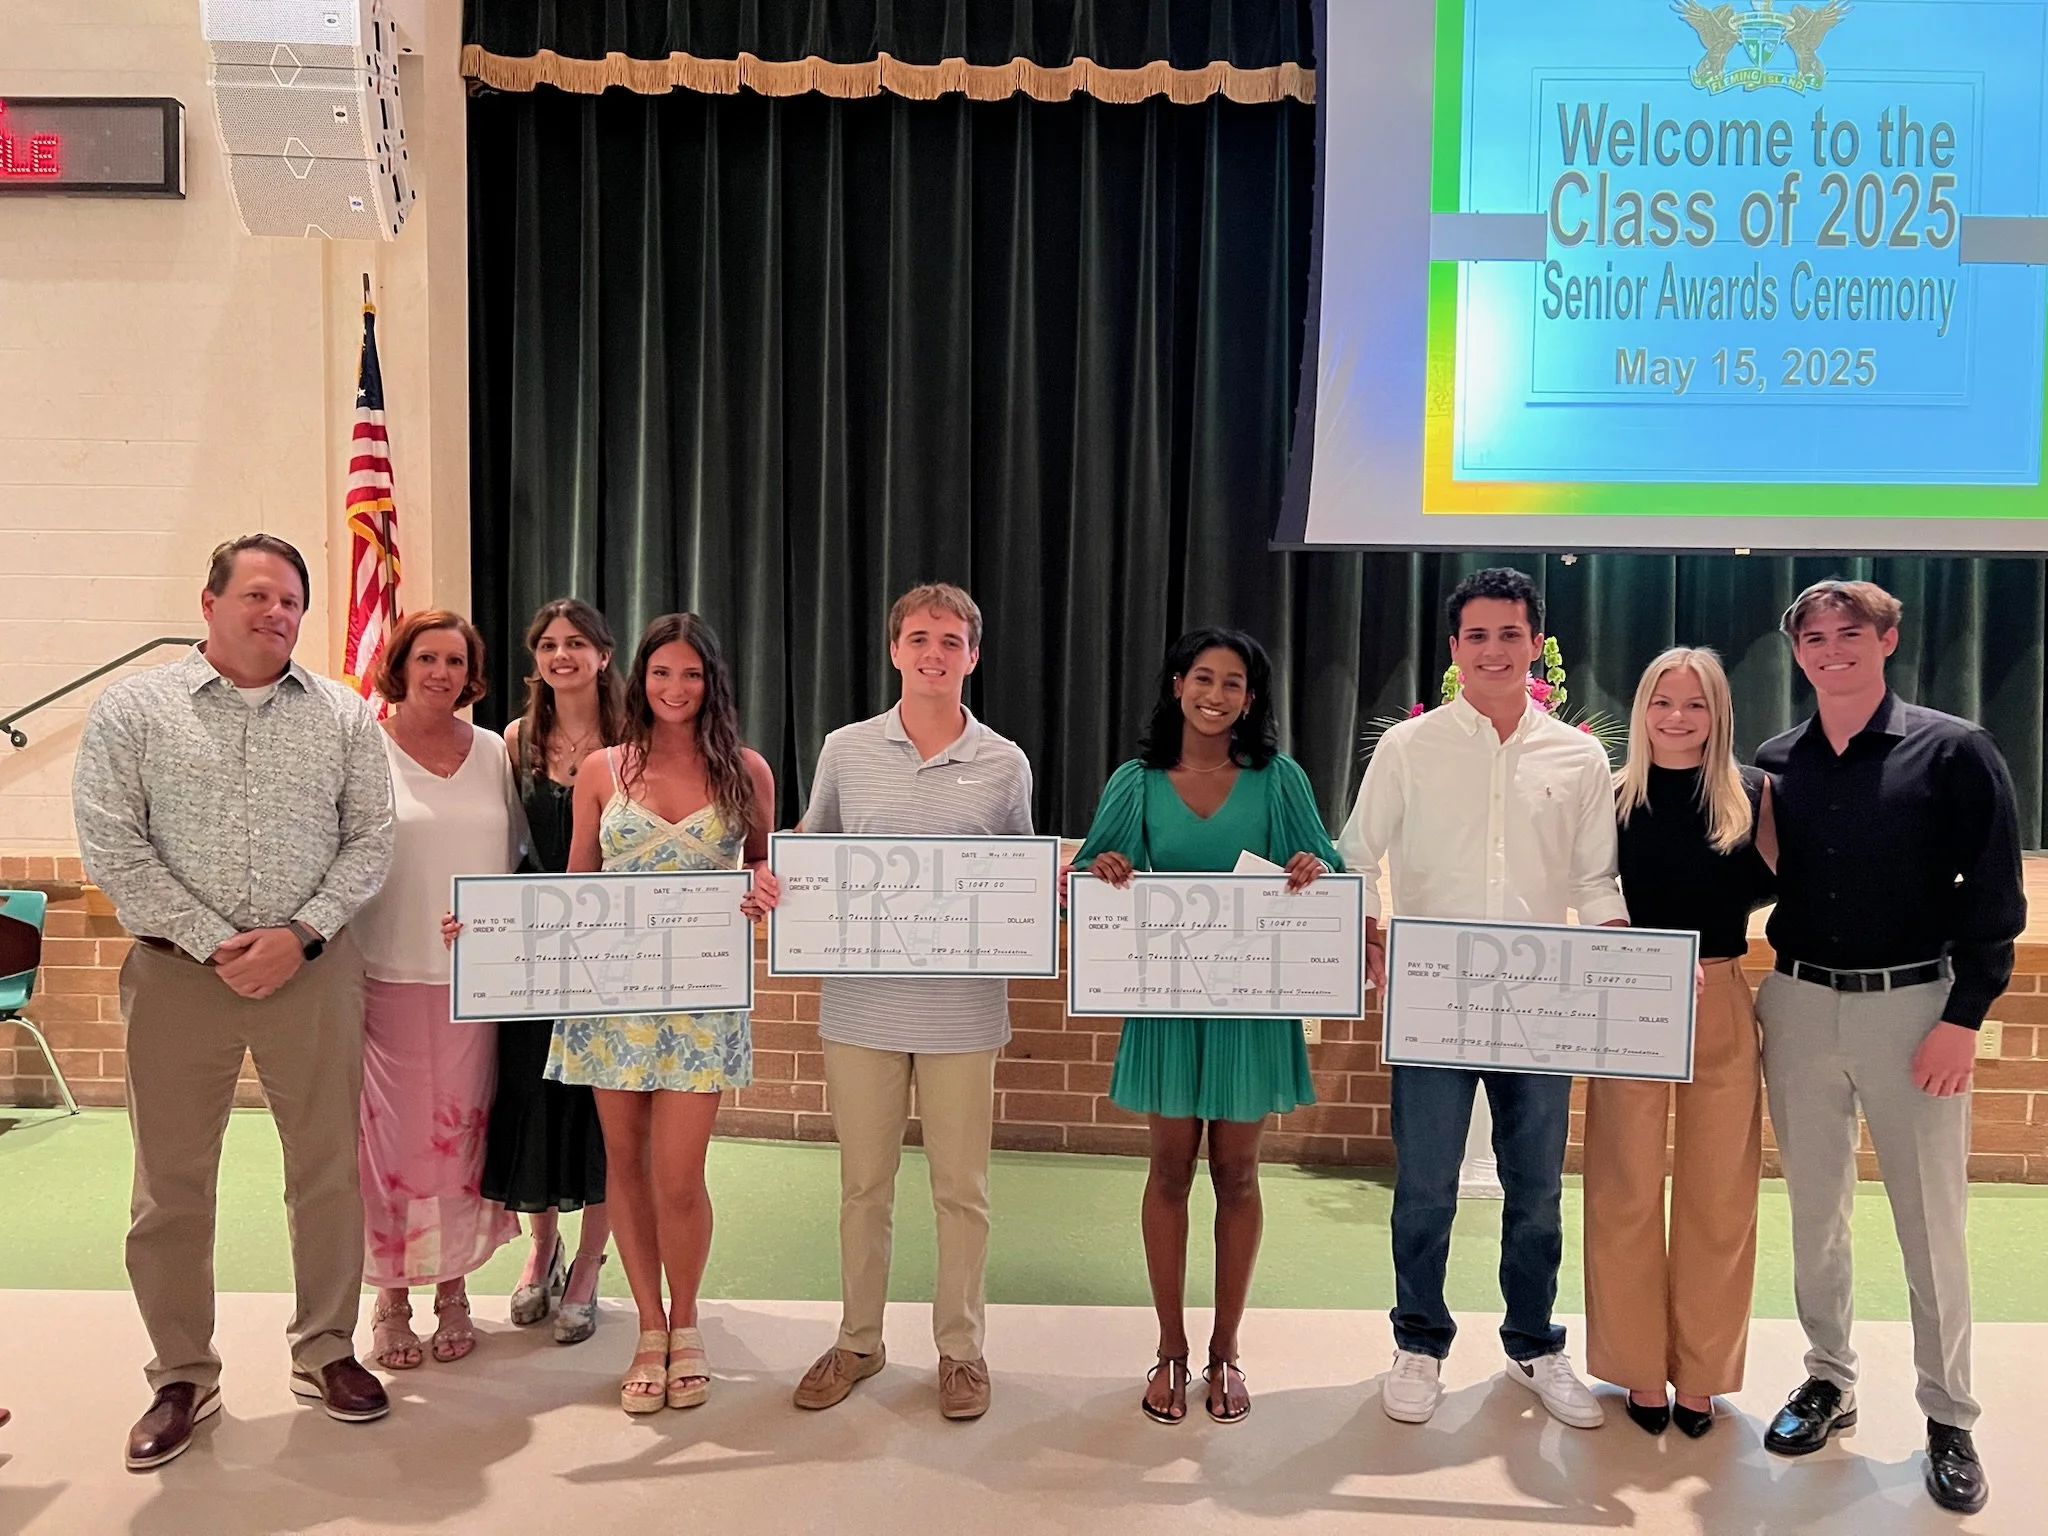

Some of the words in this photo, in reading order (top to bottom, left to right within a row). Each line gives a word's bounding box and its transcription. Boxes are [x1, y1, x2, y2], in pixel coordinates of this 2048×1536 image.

[1711, 70, 1760, 92] FLEMING
[1763, 74, 1803, 90] ISLAND
[1557, 102, 1793, 167] Welcome
[1811, 104, 1860, 167] to
[1878, 105, 1956, 168] the
[0, 135, 58, 173] LE
[1549, 170, 1716, 248] Class
[1739, 171, 1801, 248] of
[1815, 171, 1958, 249] 2025
[1542, 259, 1648, 321] Senior
[1655, 260, 1778, 322] Awards
[1790, 259, 1957, 338] Ceremony
[1614, 347, 1697, 395] May
[1711, 349, 1766, 393] 15,
[1780, 348, 1877, 387] 2025
[957, 880, 964, 889] $
[650, 916, 656, 926] $
[1259, 919, 1265, 928] $
[1586, 974, 1593, 984] $
[552, 987, 593, 995] Scholarship
[1447, 1002, 1463, 1010] One
[1468, 1003, 1511, 1012] Thousand
[1638, 1016, 1669, 1024] DOLLARS
[1484, 1040, 1524, 1048] Scholarship
[1622, 1047, 1660, 1056] Foundation
